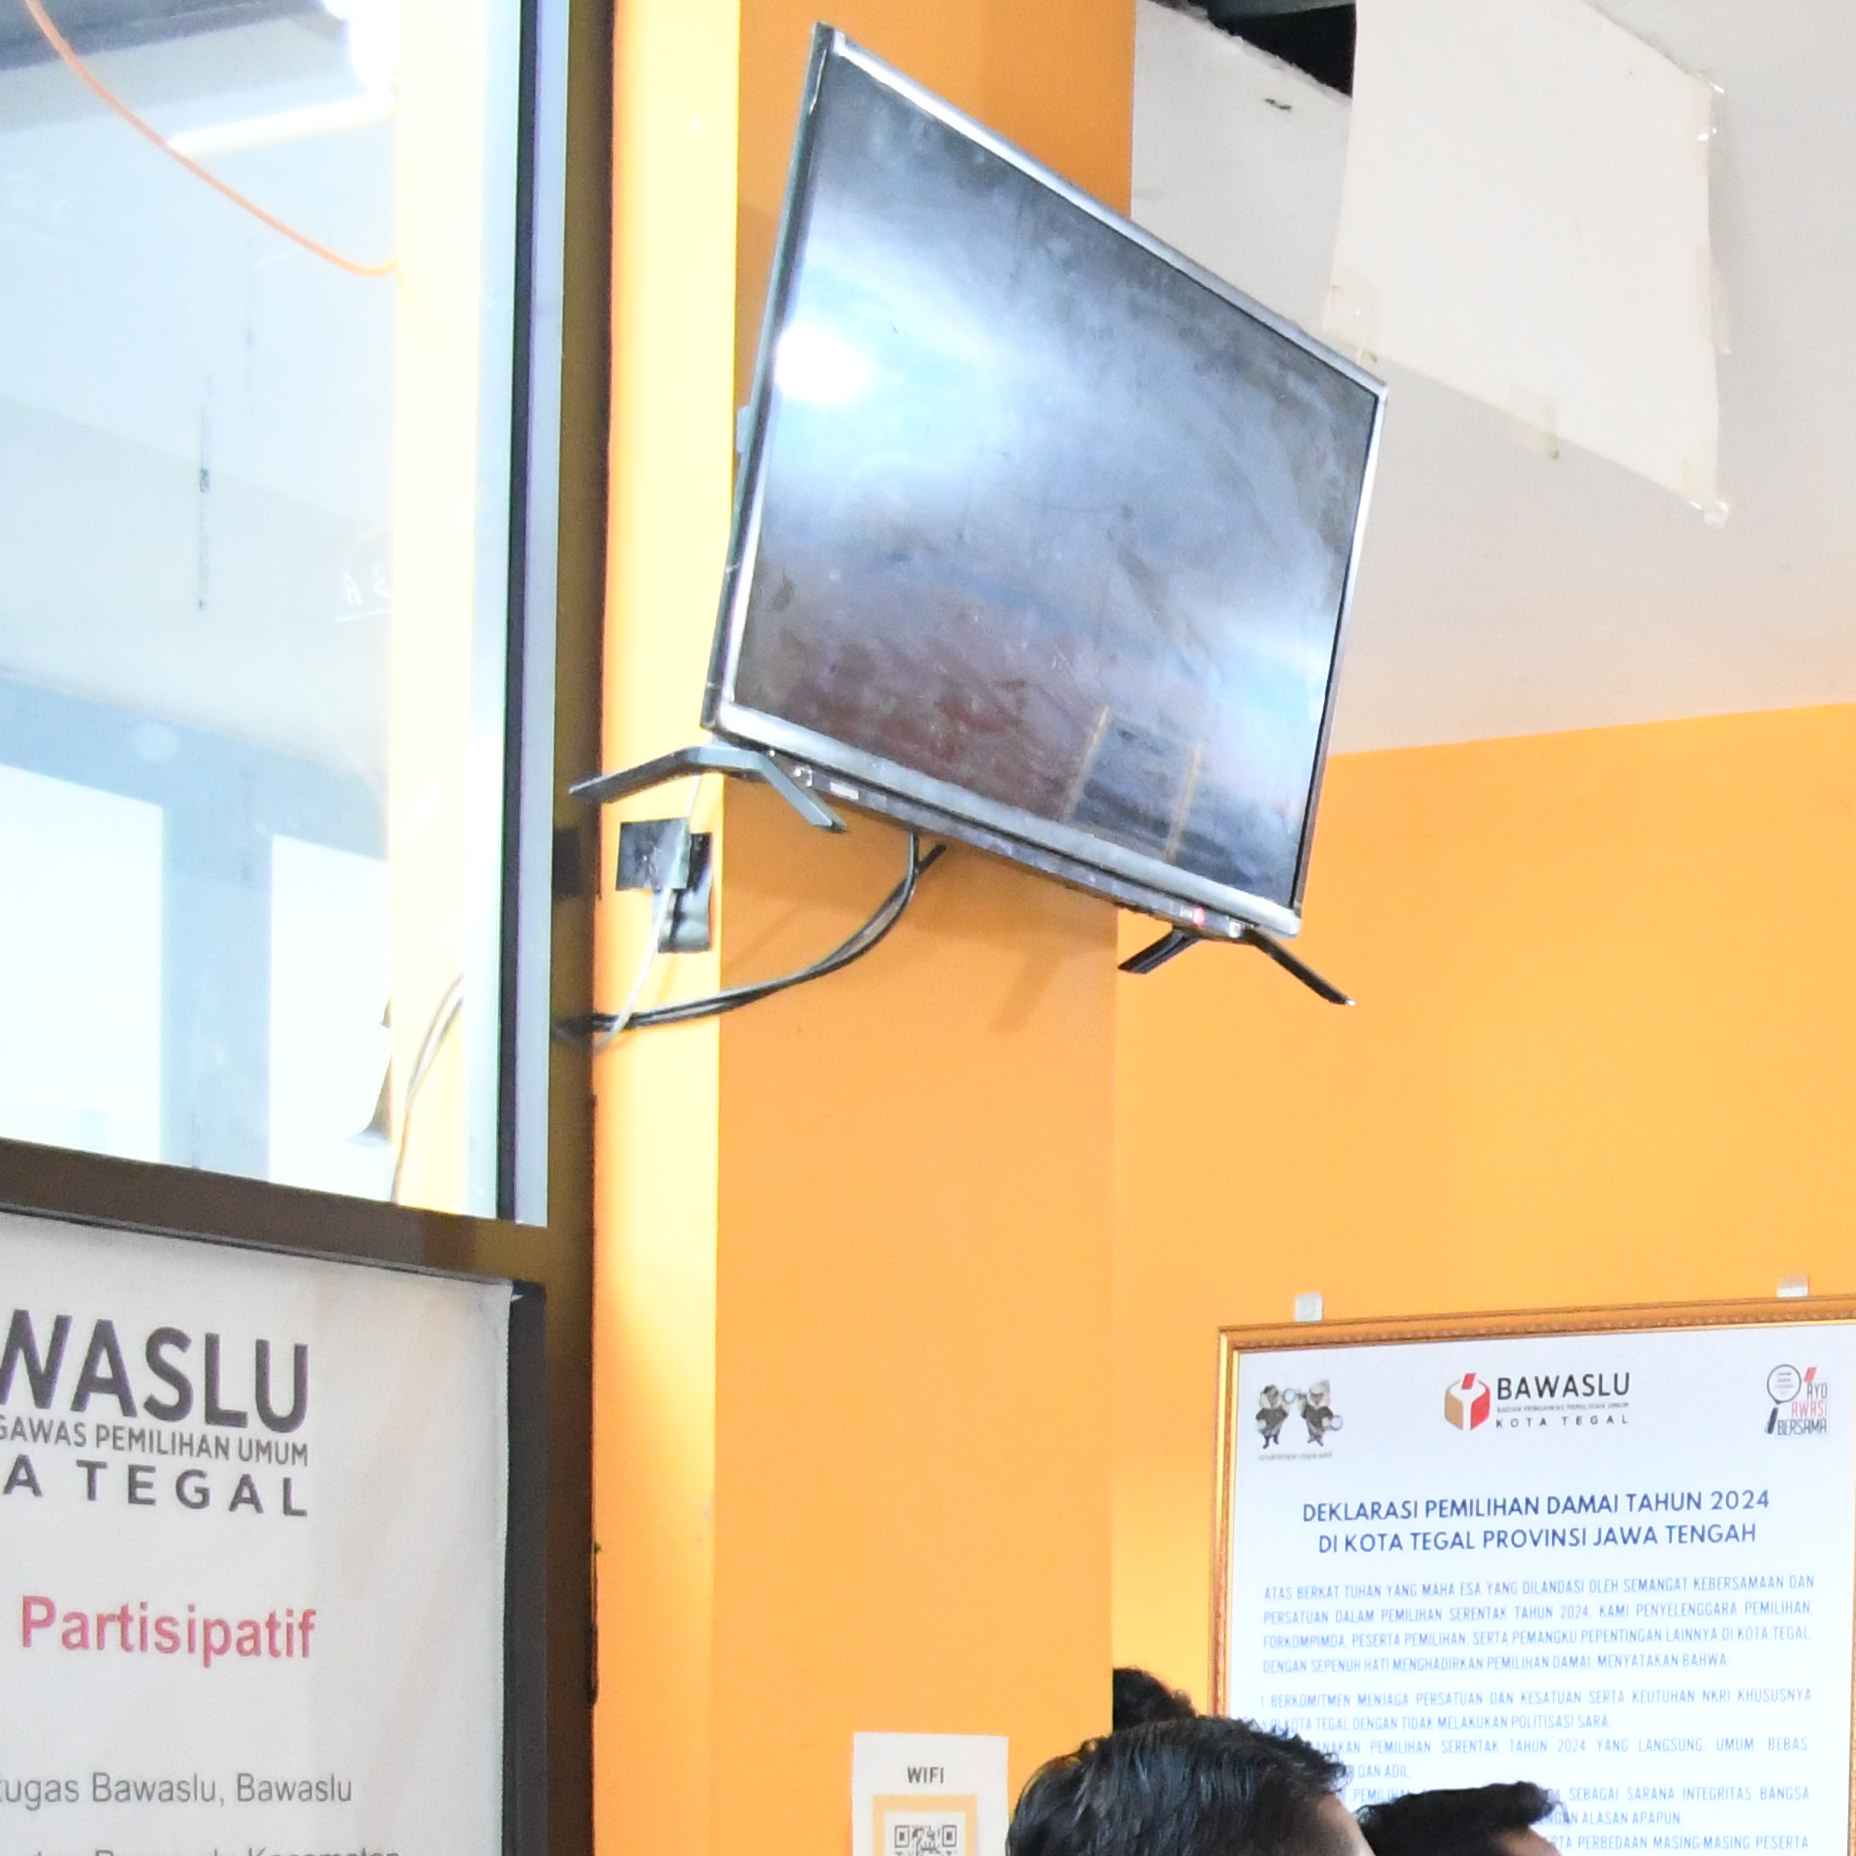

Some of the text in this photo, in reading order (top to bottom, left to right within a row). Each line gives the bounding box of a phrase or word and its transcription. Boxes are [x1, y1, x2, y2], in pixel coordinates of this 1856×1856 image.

[1497, 1372, 1630, 1400] BAWASLU
[1496, 1414, 1630, 1429] KOTA TEGAL
[1777, 1417, 1828, 1436] BERSAMA
[95, 1423, 231, 1460] PEMILIHAN
[238, 1438, 309, 1467] UMUM
[76, 1459, 308, 1517] TEGAL
[1303, 1489, 1770, 1521] DEKLARASI PEMILIHAN DAMAI TAHUN 2024
[1319, 1523, 1756, 1553] DI KOTA TEGAL PROVINSI JAWA TENGAH
[1344, 1584, 1381, 1599] TUHAN
[1386, 1583, 1417, 1598] YANG
[1422, 1583, 1455, 1597] MAHA
[1487, 1582, 1517, 1595] YANG
[1589, 1580, 1618, 1593] OLEH
[1623, 1577, 1687, 1592] SEMANGAT
[1693, 1576, 1783, 1591] KEBERSAMAAN
[1789, 1575, 1814, 1589] DAN
[1335, 1609, 1374, 1624] DALAM
[1380, 1608, 1442, 1623] PEMILIHAN
[1514, 1605, 1553, 1620] TAHUN
[1599, 1604, 1629, 1618] KAMI
[21, 1594, 318, 1669] Partisipatif
[1487, 1655, 1549, 1670] PEMILIHAN
[1597, 1652, 1679, 1668] MENYATAKAN
[906, 1766, 945, 1784] WIFI
[0, 1771, 353, 1812] ugas Bawaslu, Bawaslu
